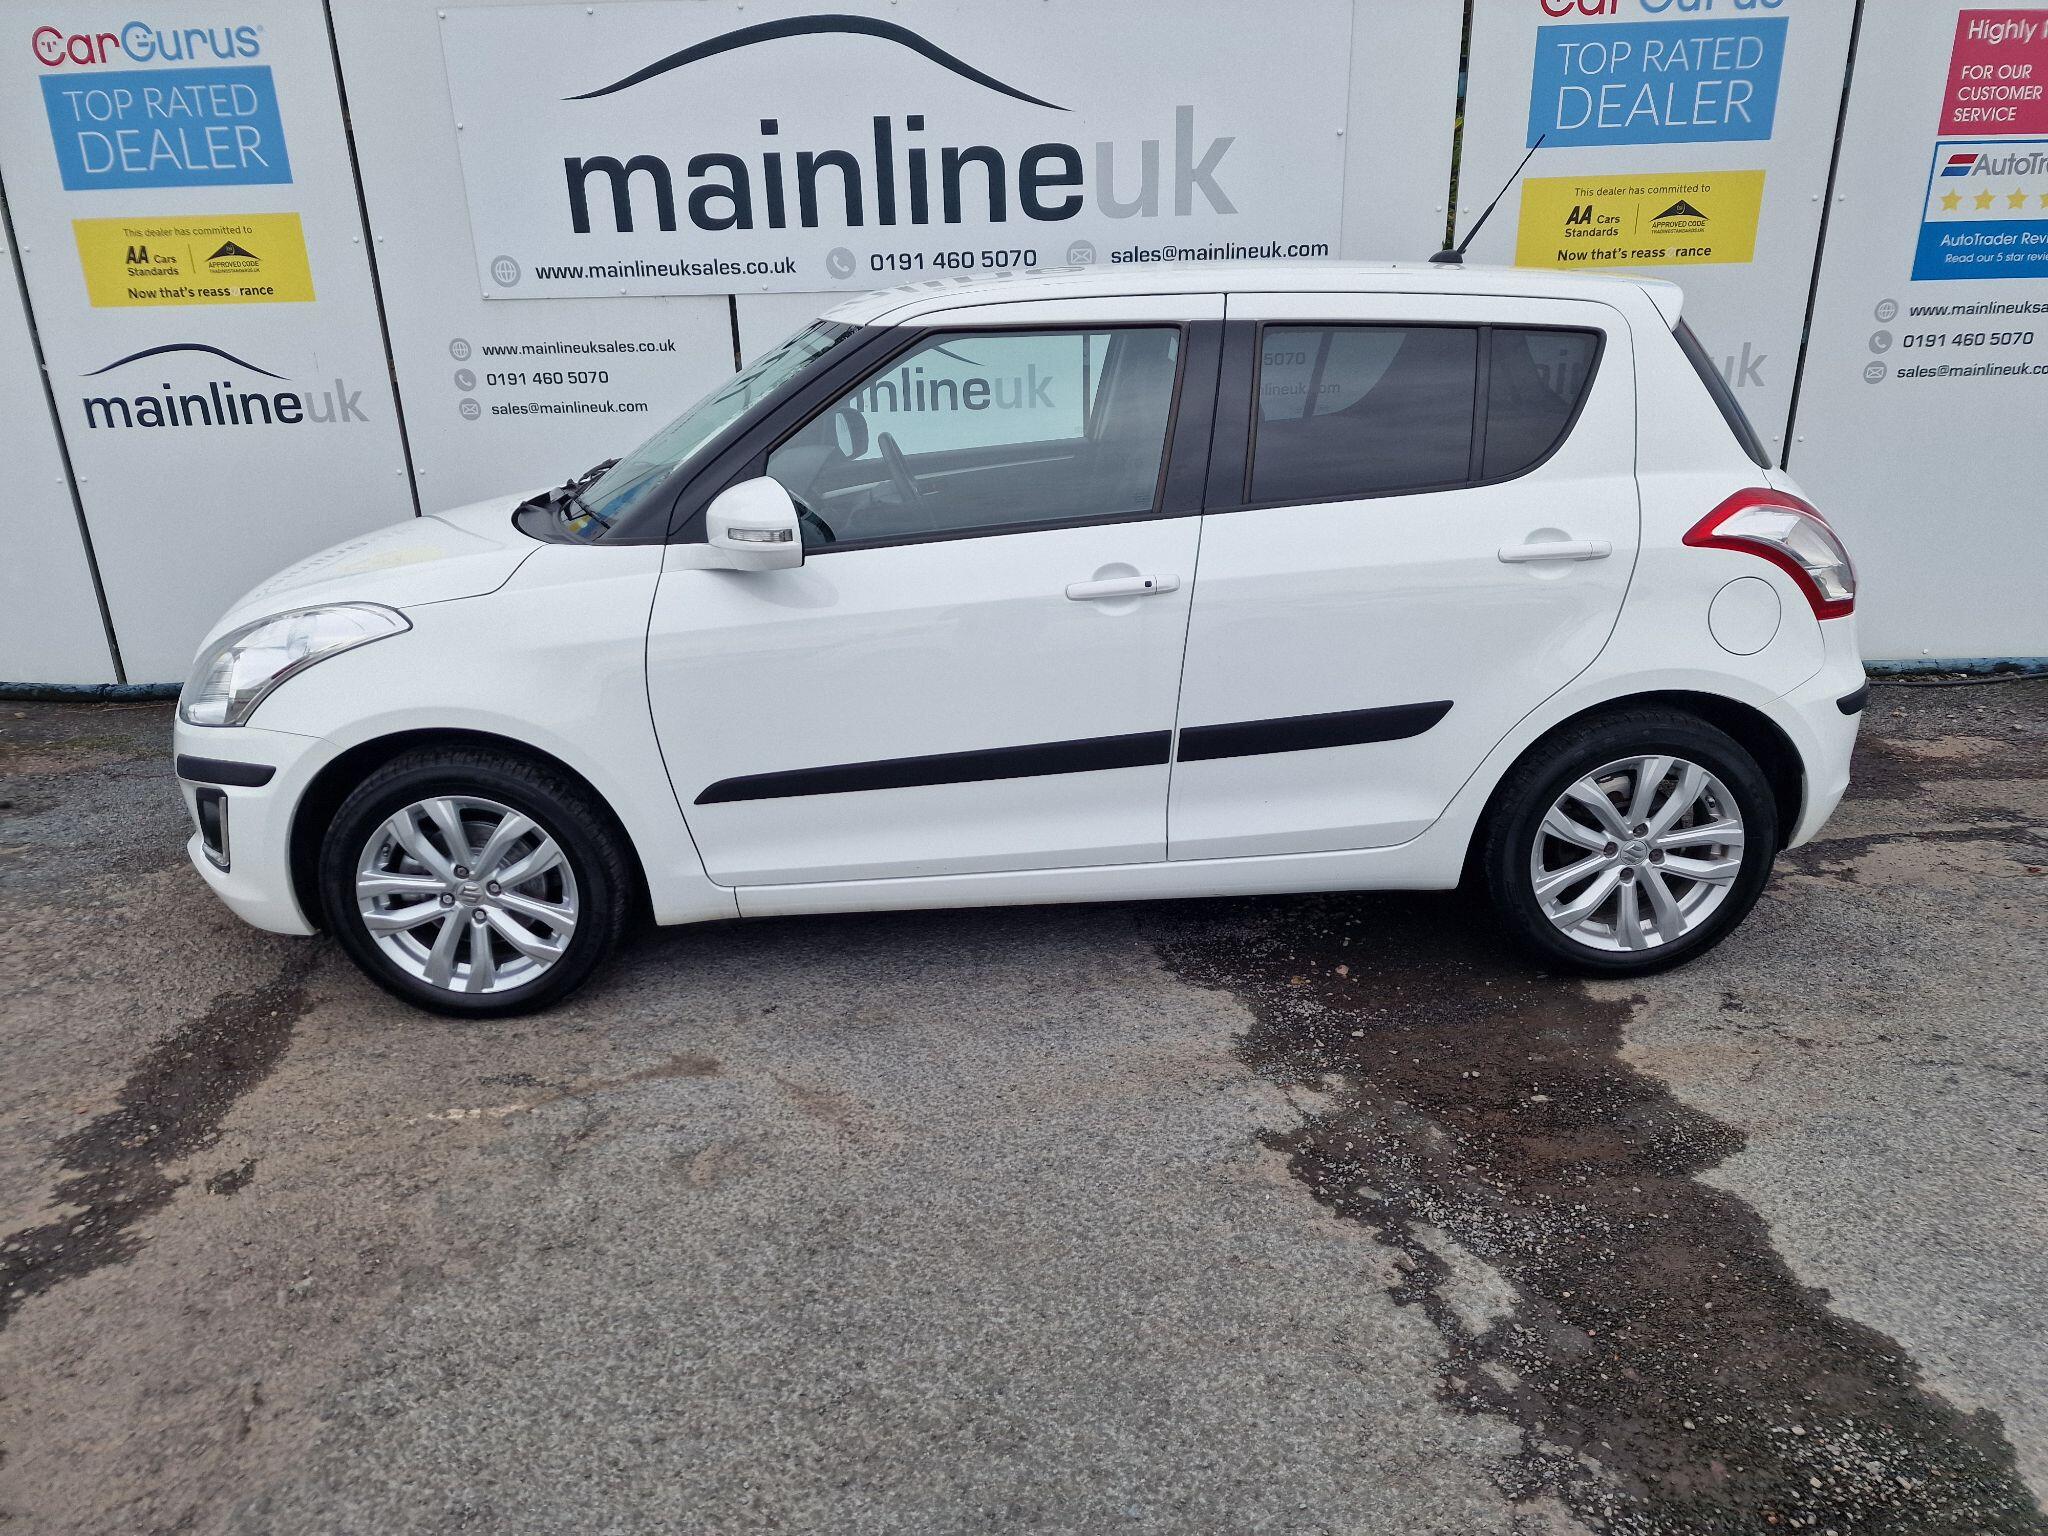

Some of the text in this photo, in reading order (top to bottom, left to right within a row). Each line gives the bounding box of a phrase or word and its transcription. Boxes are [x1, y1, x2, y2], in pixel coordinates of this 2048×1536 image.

[1968, 19, 2038, 44] Highly
[32, 21, 260, 66] CarGurus
[1557, 36, 1764, 75] TOP RATED
[1961, 64, 2033, 80] FOR OUR
[1958, 86, 2043, 101] CUSTOMER
[62, 84, 257, 122] TOP RATED
[1556, 79, 1754, 130] DEALER
[1954, 107, 2017, 122] SERVICE
[77, 126, 269, 173] DEALER
[563, 104, 1240, 234] mainlineuk
[1971, 153, 2048, 176] AutoTr
[1575, 184, 1711, 197] This dealer has committed to
[1565, 205, 1621, 225] AA Cars
[123, 225, 253, 238] This dealer has committed to
[1565, 227, 1619, 238] Standards
[1940, 233, 2018, 247] AutoTrader
[126, 245, 177, 264] AA Cars
[870, 250, 1037, 271] 0191 460 5070
[1111, 241, 1329, 264] sales@mainlineuk.com
[1557, 247, 1712, 262] Now that's reassrance
[1945, 253, 1974, 263] Read
[1976, 254, 1995, 262] our
[1997, 252, 2004, 261] 5
[2006, 252, 2025, 262] star
[127, 267, 180, 277] Standards
[535, 256, 797, 280] www.mainlineuksales.co.uk
[128, 286, 274, 299] Now that's reassrance
[482, 339, 676, 356] www.mainlineuksales.co.uk
[1903, 332, 2034, 348] 0191 460 5070
[1264, 352, 1306, 366] 5070
[487, 370, 609, 386] 0191 460 5070
[82, 378, 371, 429] mainlineuk
[491, 400, 648, 415] sales@mainlineuk.com
